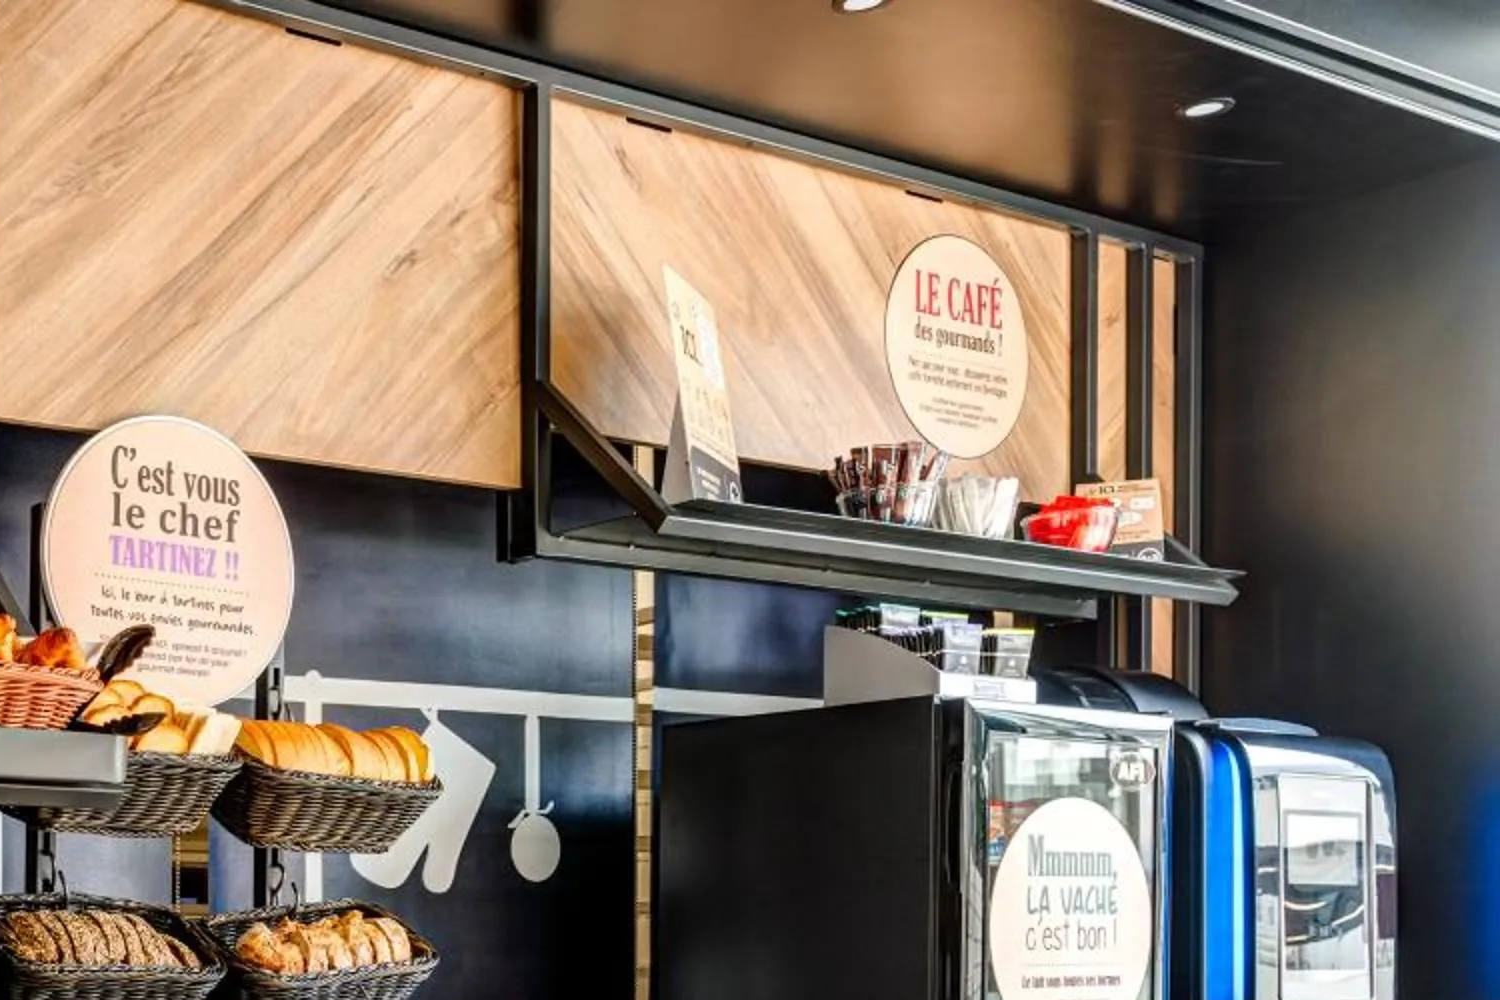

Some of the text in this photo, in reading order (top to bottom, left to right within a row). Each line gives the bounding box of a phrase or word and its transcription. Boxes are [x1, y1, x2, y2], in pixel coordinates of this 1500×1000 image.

[916, 269, 1003, 330] LE CAFÉ
[914, 316, 933, 342] des
[936, 328, 995, 355] gourmands
[111, 445, 241, 507] C'est vous
[112, 492, 241, 543] le chef
[109, 535, 217, 579] TARTINEZ
[1027, 885, 1118, 915] LA VACHE
[1077, 918, 1107, 951] bon
